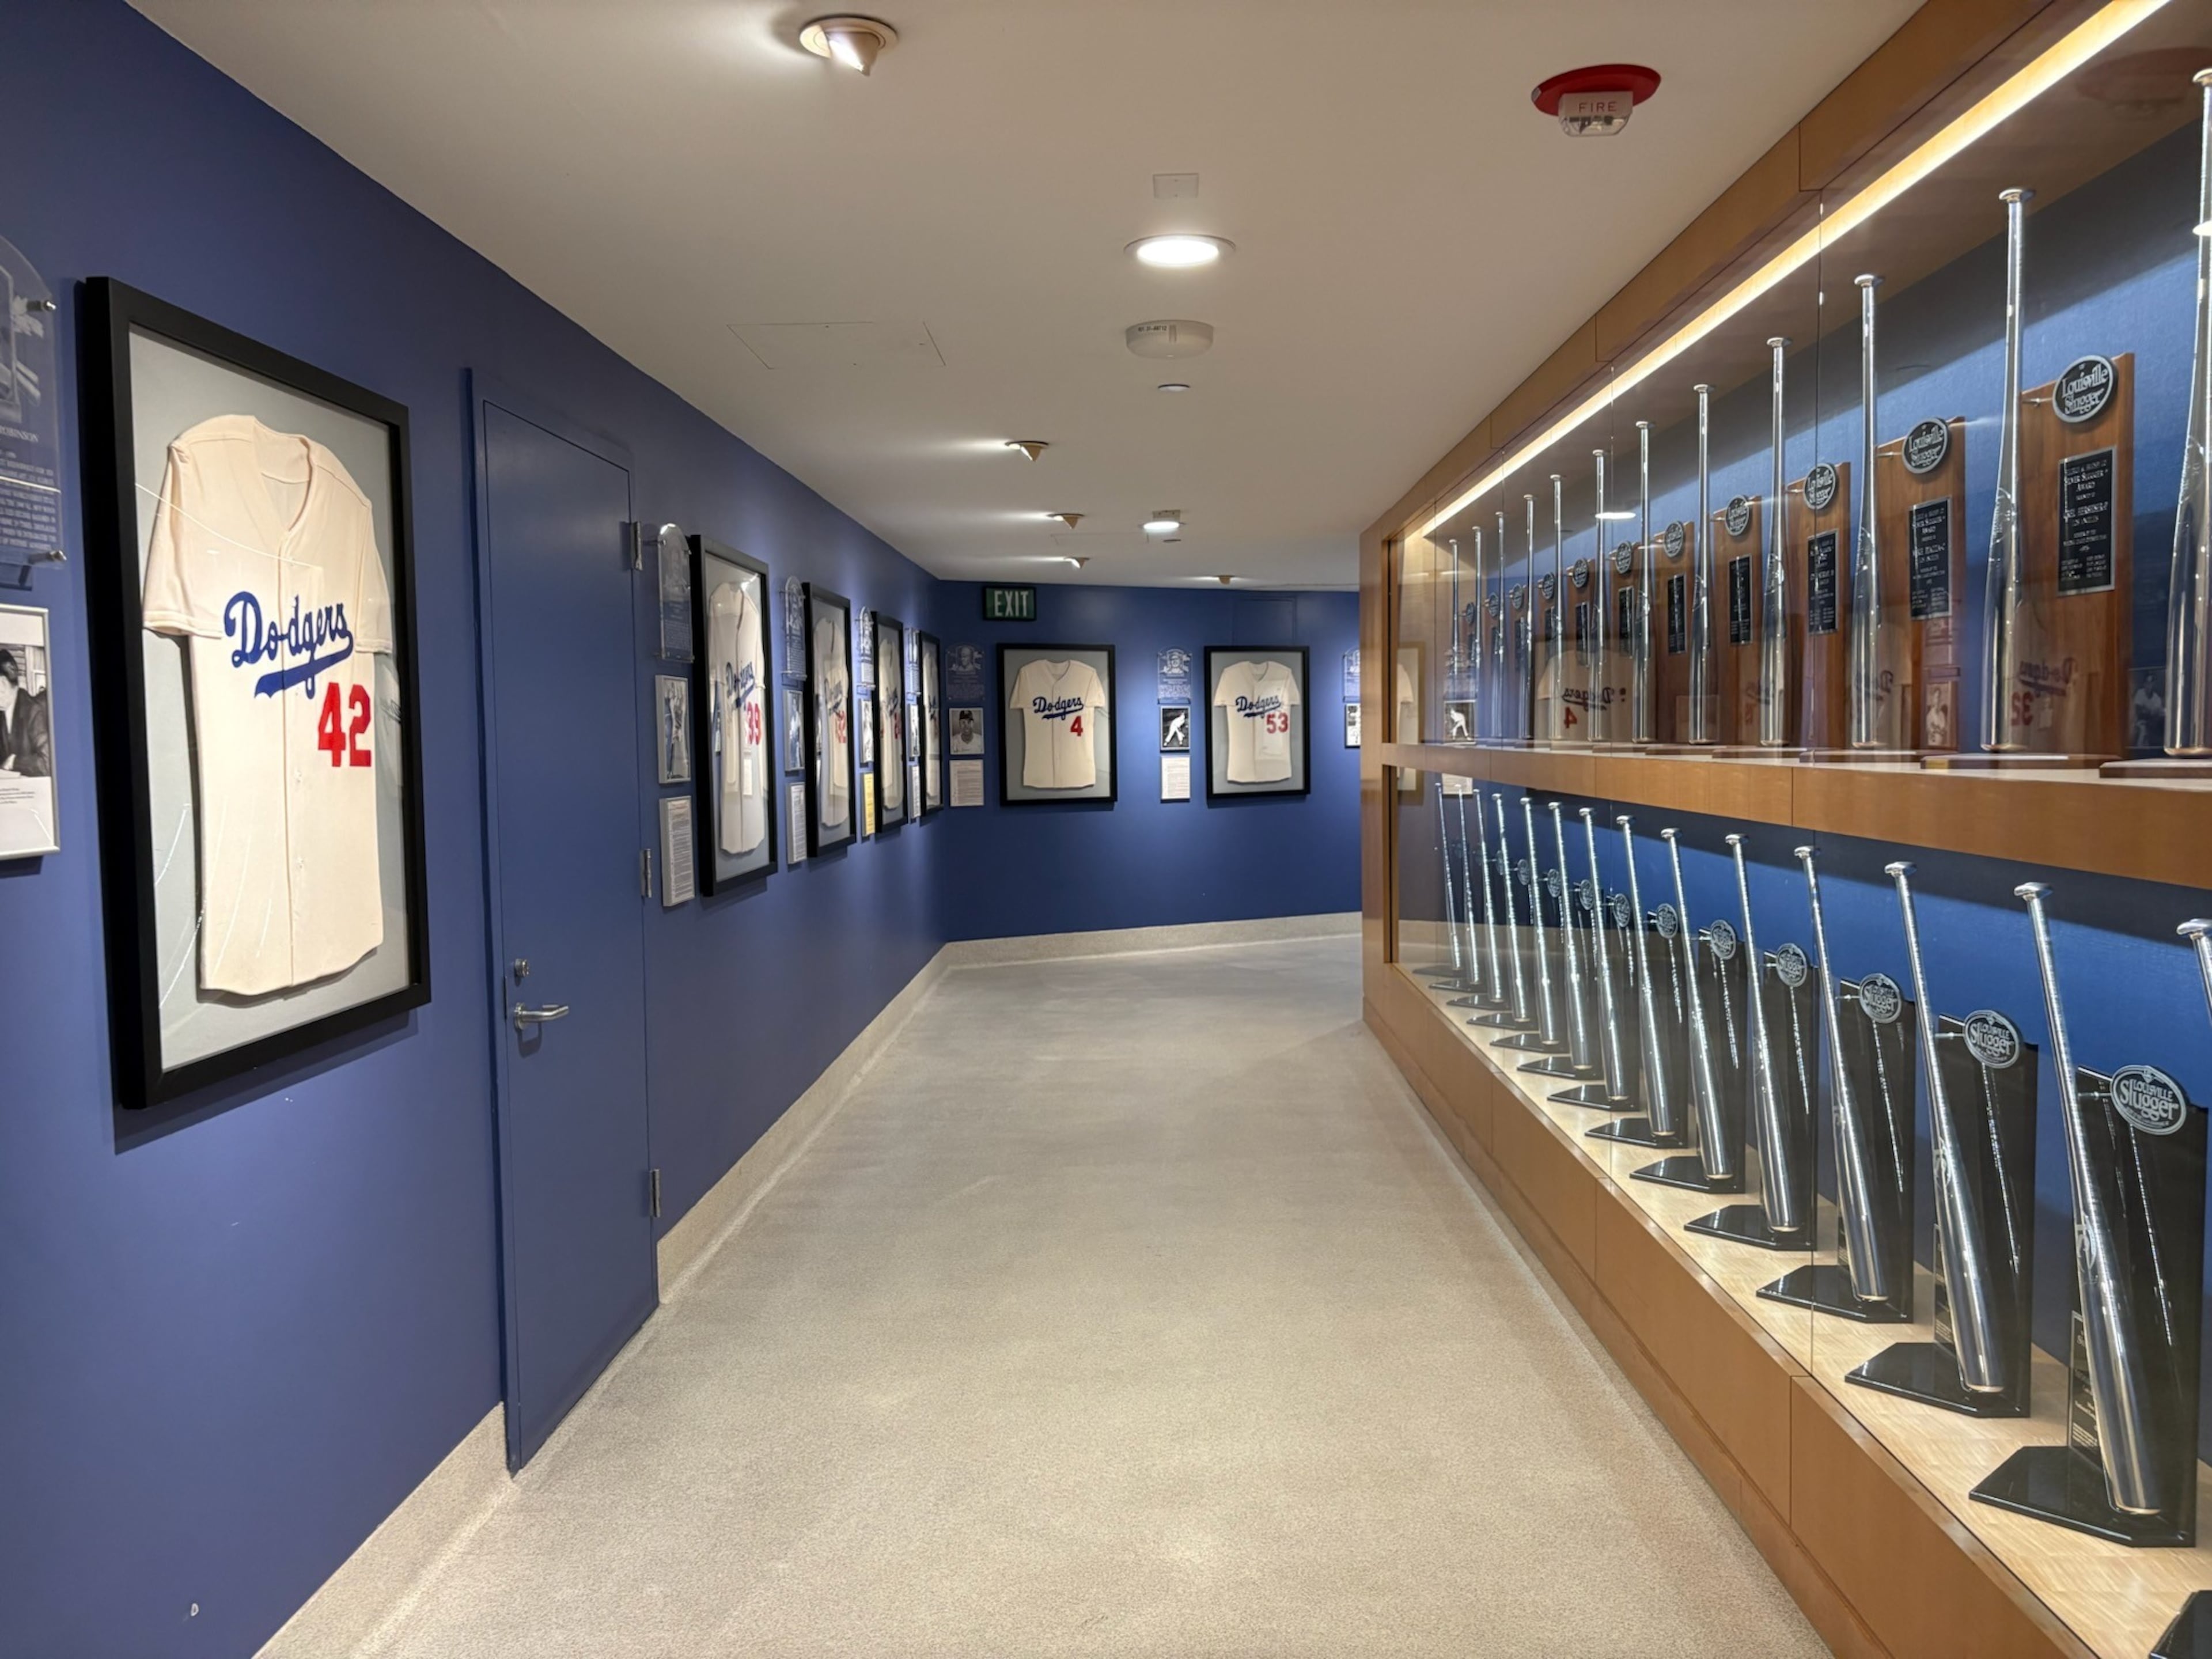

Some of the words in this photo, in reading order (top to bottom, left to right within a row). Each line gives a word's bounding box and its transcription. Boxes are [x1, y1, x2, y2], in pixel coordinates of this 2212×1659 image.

[1578, 101, 1618, 113] FIRE
[2062, 363, 2109, 399] Louisville
[2064, 388, 2105, 414] Slugger
[994, 590, 1029, 618] EXIT
[224, 591, 354, 700] Dodgers
[1033, 696, 1084, 720] Dodgers
[1235, 695, 1282, 719] Dodgers
[318, 682, 372, 767] 42
[747, 701, 762, 745] 39
[1070, 715, 1084, 737] 4
[1267, 712, 1289, 734] 53
[1970, 1022, 2015, 1056] Slugger
[2119, 1078, 2179, 1121] Slugger
[2131, 1079, 2173, 1102] LOUISVILLE
